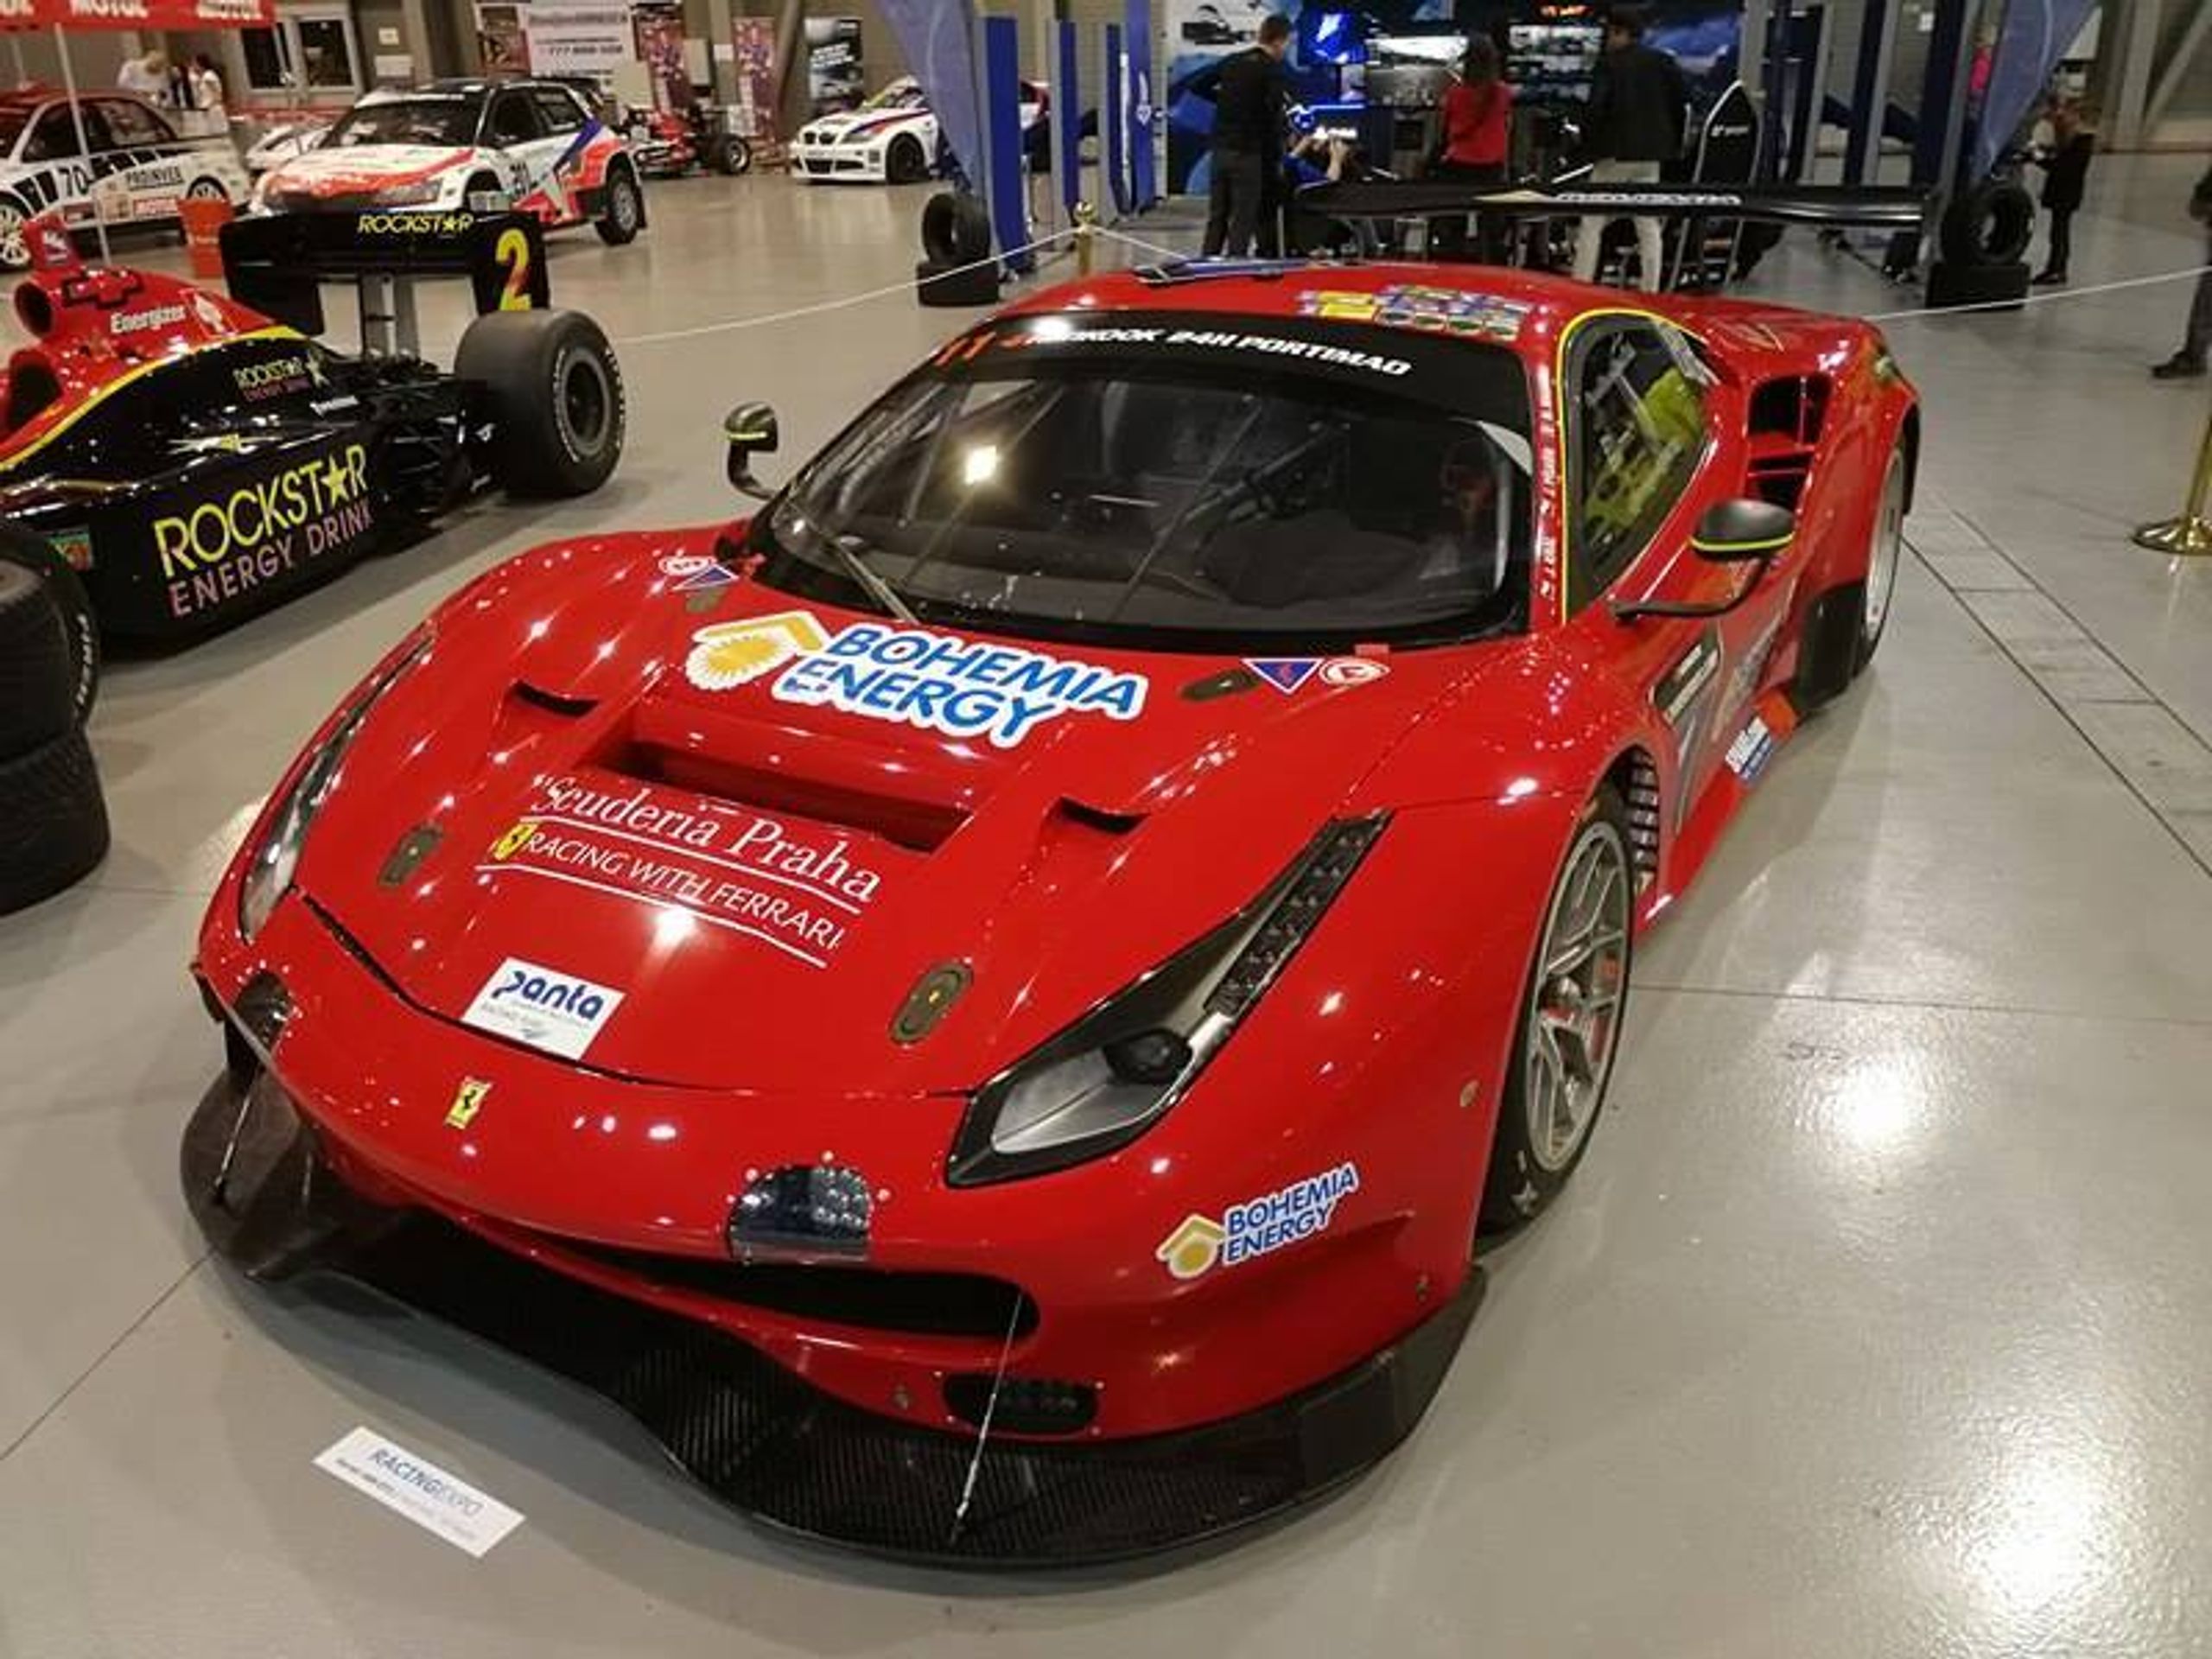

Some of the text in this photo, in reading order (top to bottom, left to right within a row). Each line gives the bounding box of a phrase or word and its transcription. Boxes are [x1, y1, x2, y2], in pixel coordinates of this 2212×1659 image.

[495, 228, 532, 312] 2
[168, 498, 375, 617] ENERGY DRINK
[779, 658, 1058, 740] ENERGY
[826, 628, 1141, 714] BOHEMIA
[531, 774, 882, 903] Scuderia Praha
[524, 830, 844, 950] RACING WITH FERRARI
[492, 970, 605, 1021] panta
[1225, 1202, 1335, 1262] ENERGY
[1228, 1166, 1356, 1236] BOHEMIA
